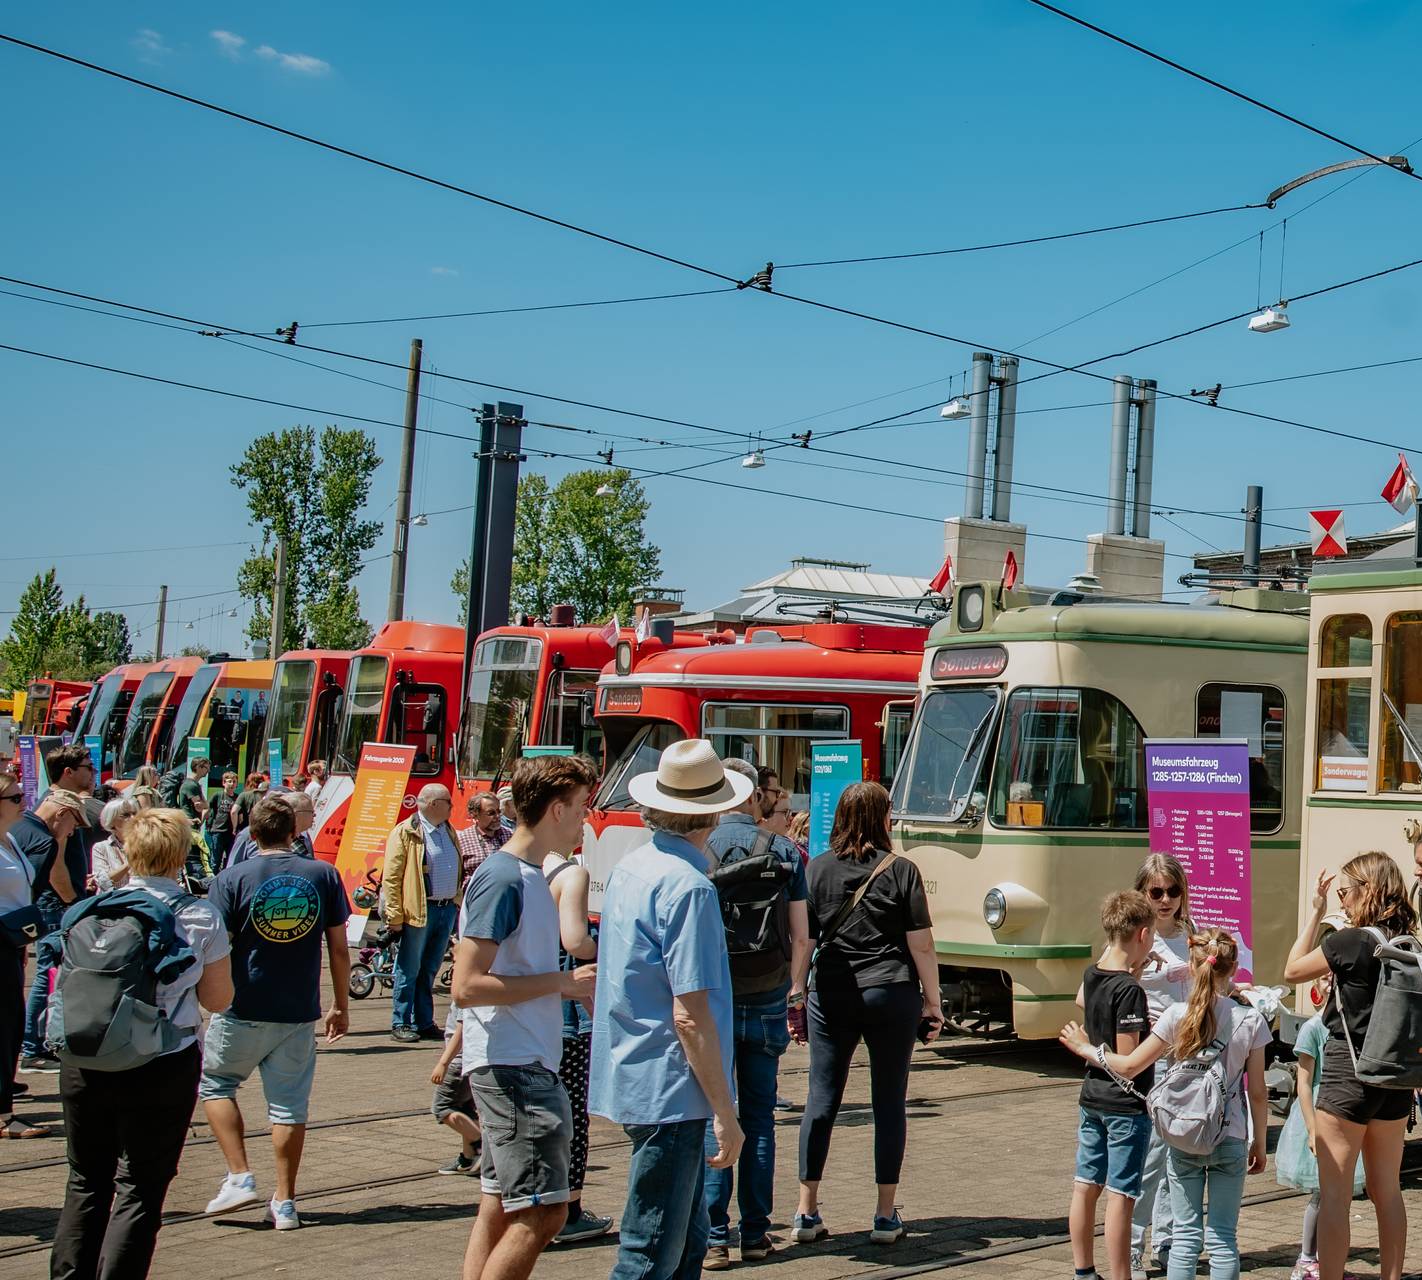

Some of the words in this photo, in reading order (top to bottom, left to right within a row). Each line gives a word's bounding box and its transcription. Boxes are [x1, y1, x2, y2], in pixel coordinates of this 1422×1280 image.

[1151, 756, 1219, 770] Museumsfahrzeug
[1152, 771, 1205, 783] 1285-1257-1286
[1206, 771, 1242, 785] (Finchen)
[255, 915, 289, 940] SUMMER
[292, 914, 316, 937] VIBES
